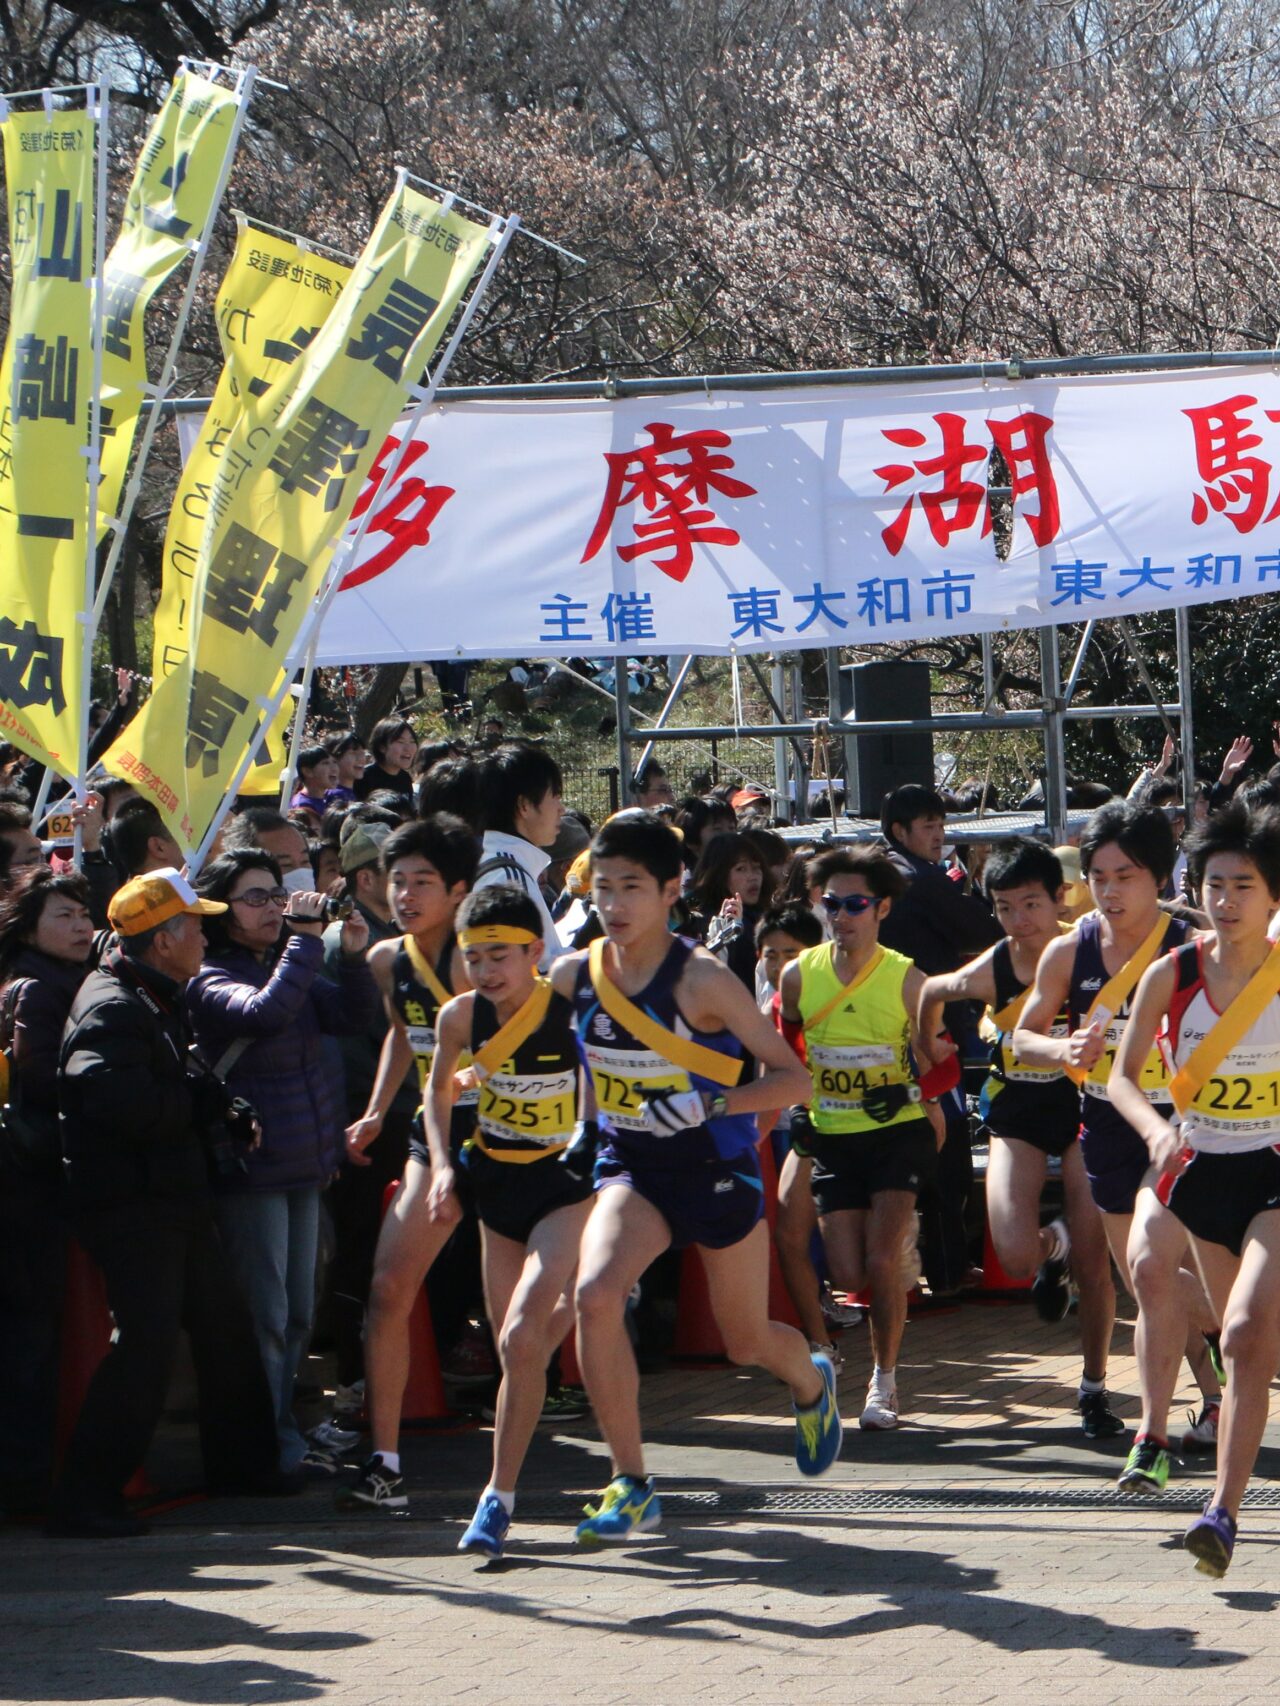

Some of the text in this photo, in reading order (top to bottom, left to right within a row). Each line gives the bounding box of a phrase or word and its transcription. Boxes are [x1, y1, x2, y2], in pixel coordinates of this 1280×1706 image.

[540, 591, 656, 643] 主催
[729, 569, 976, 640] 東大和市
[136, 986, 160, 1015] Canon
[820, 1069, 889, 1094] 604-1
